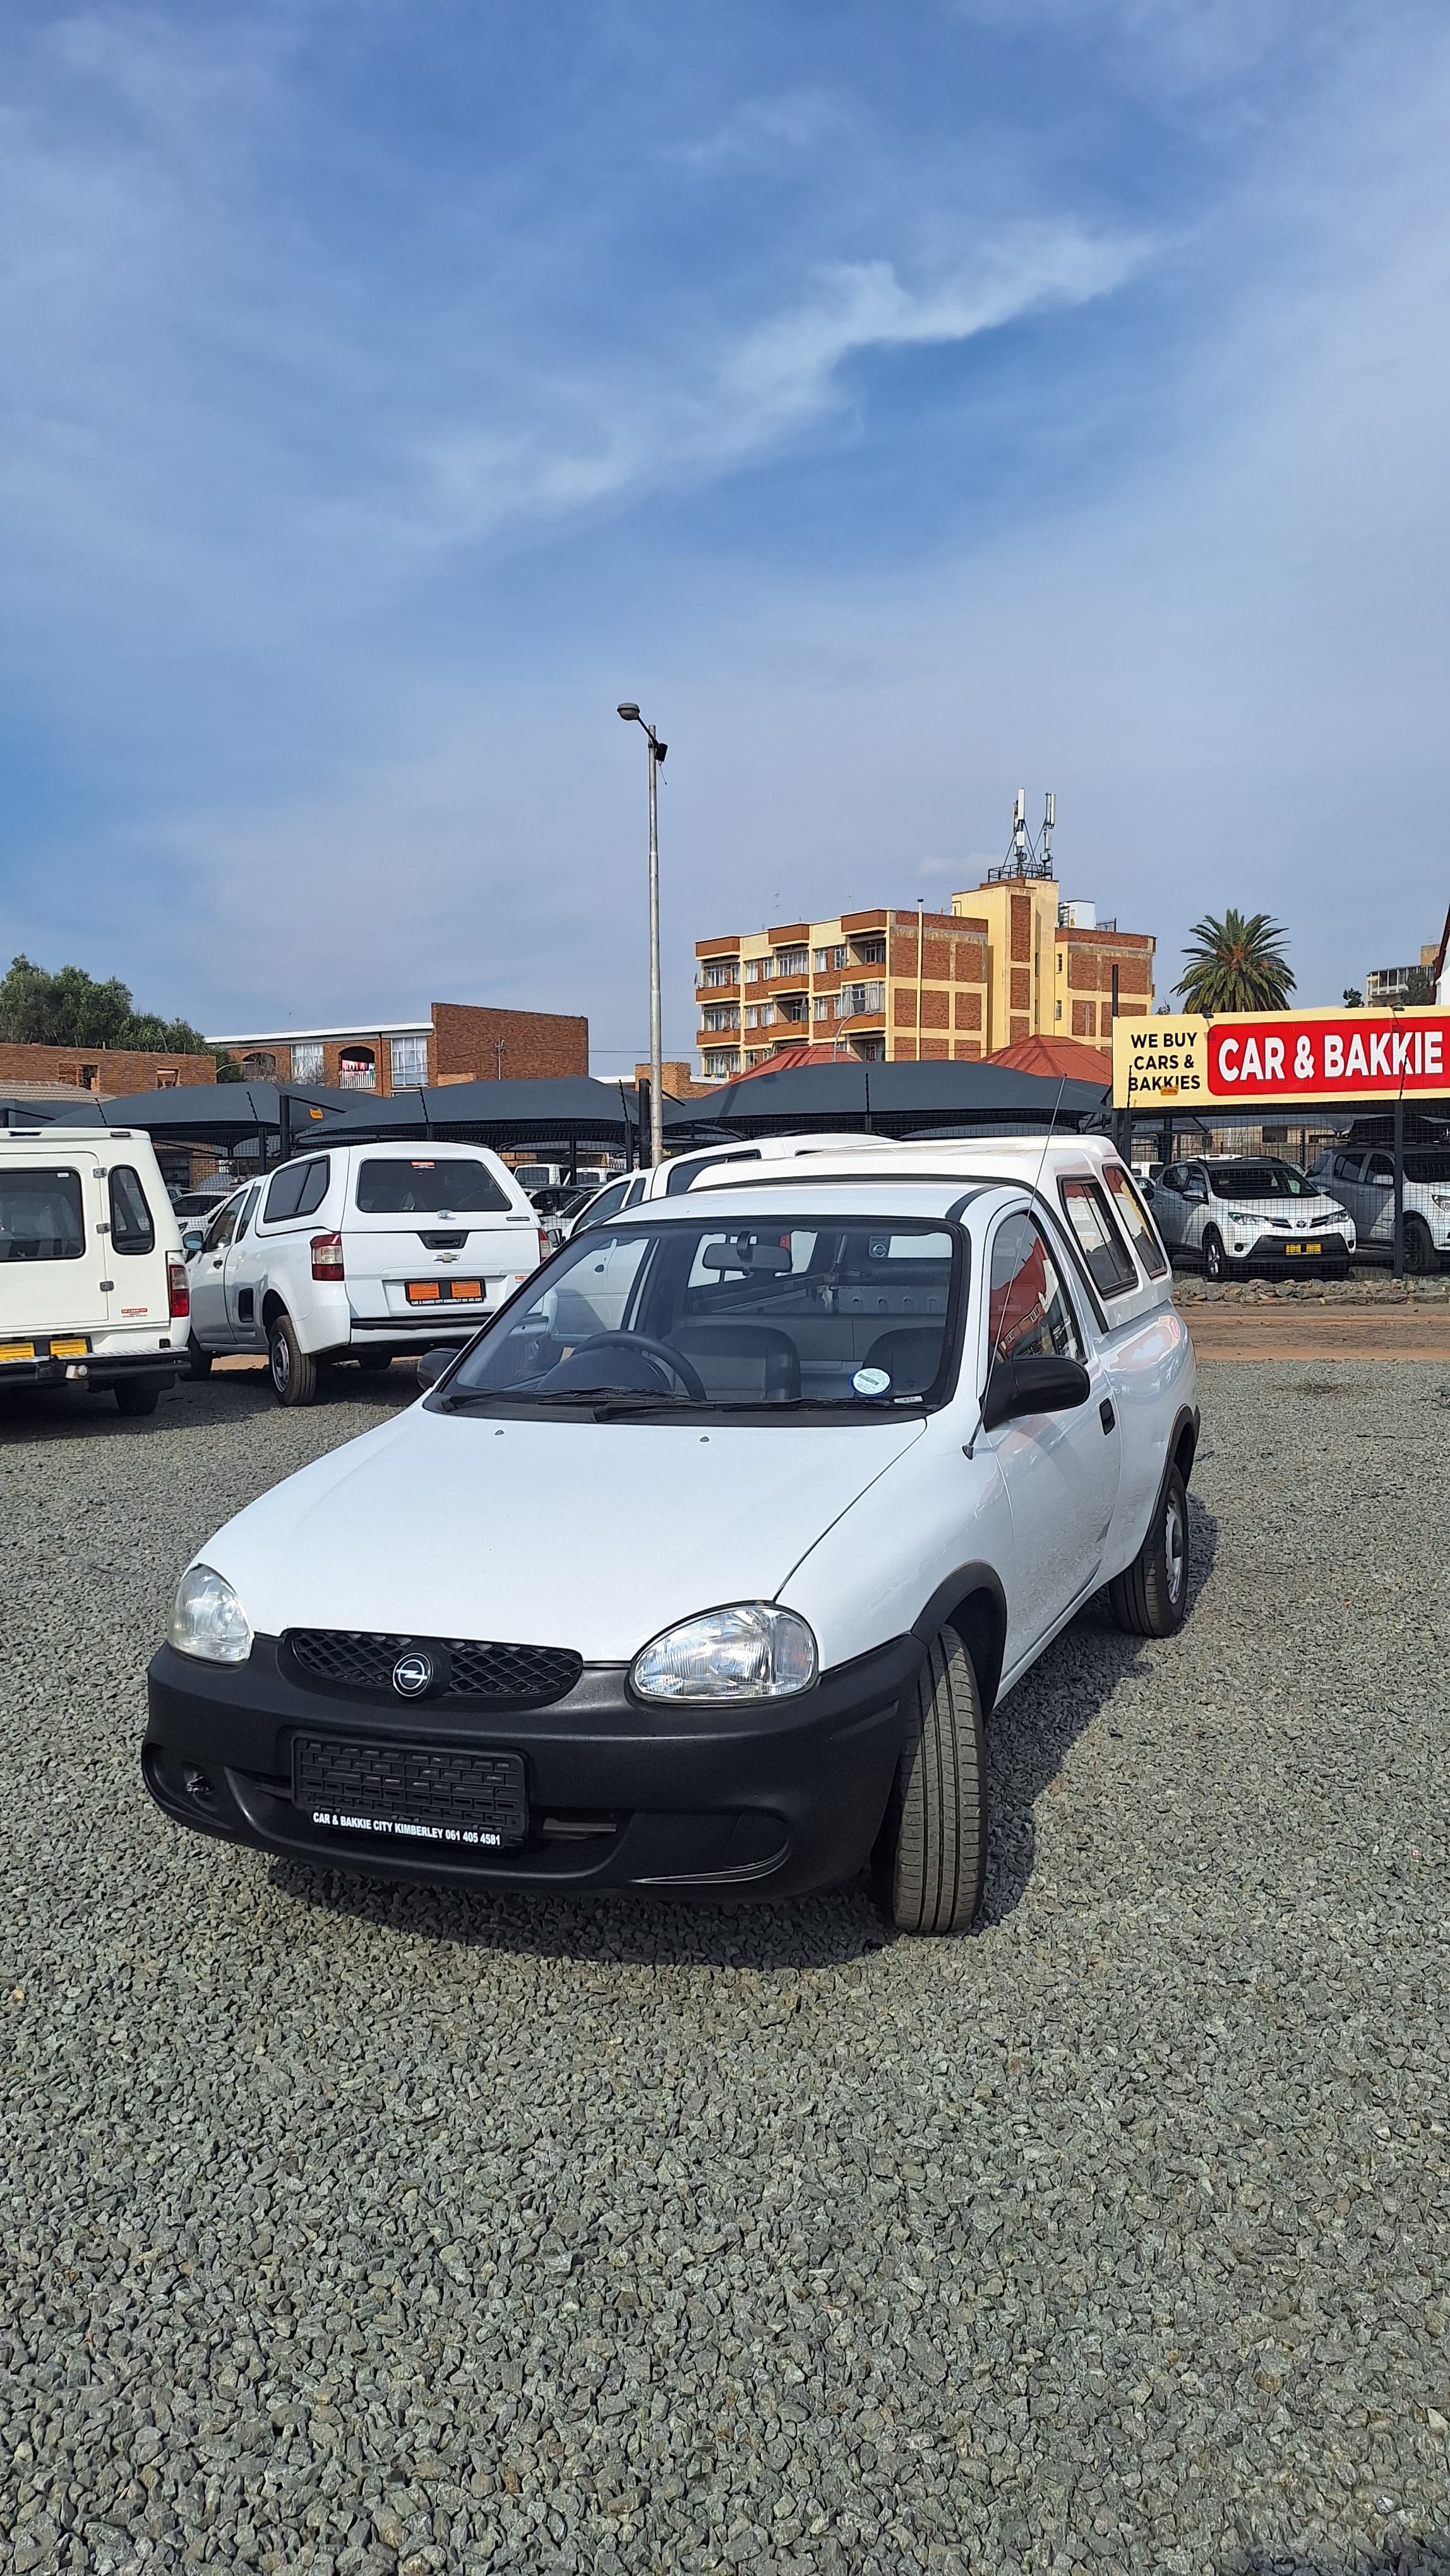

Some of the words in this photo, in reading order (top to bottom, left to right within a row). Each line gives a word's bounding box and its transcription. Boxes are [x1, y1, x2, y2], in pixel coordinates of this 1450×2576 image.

[1130, 1034, 1158, 1049] WE
[1163, 1032, 1197, 1047] BUY
[1134, 1054, 1179, 1070] CARS
[1183, 1054, 1195, 1069] &
[1218, 1036, 1285, 1082] CAR
[1294, 1035, 1315, 1079] &
[1324, 1030, 1444, 1078] BAKKIE
[1129, 1075, 1201, 1092] BAKKIES
[313, 1811, 330, 1825] CAR
[332, 1814, 339, 1825] &
[340, 1815, 372, 1830] BAKKIE
[373, 1820, 393, 1832] CITY
[394, 1822, 443, 1839] KIMBERLEY
[445, 1829, 460, 1841] 061
[462, 1831, 479, 1844] 405
[480, 1833, 501, 1846] 4581
